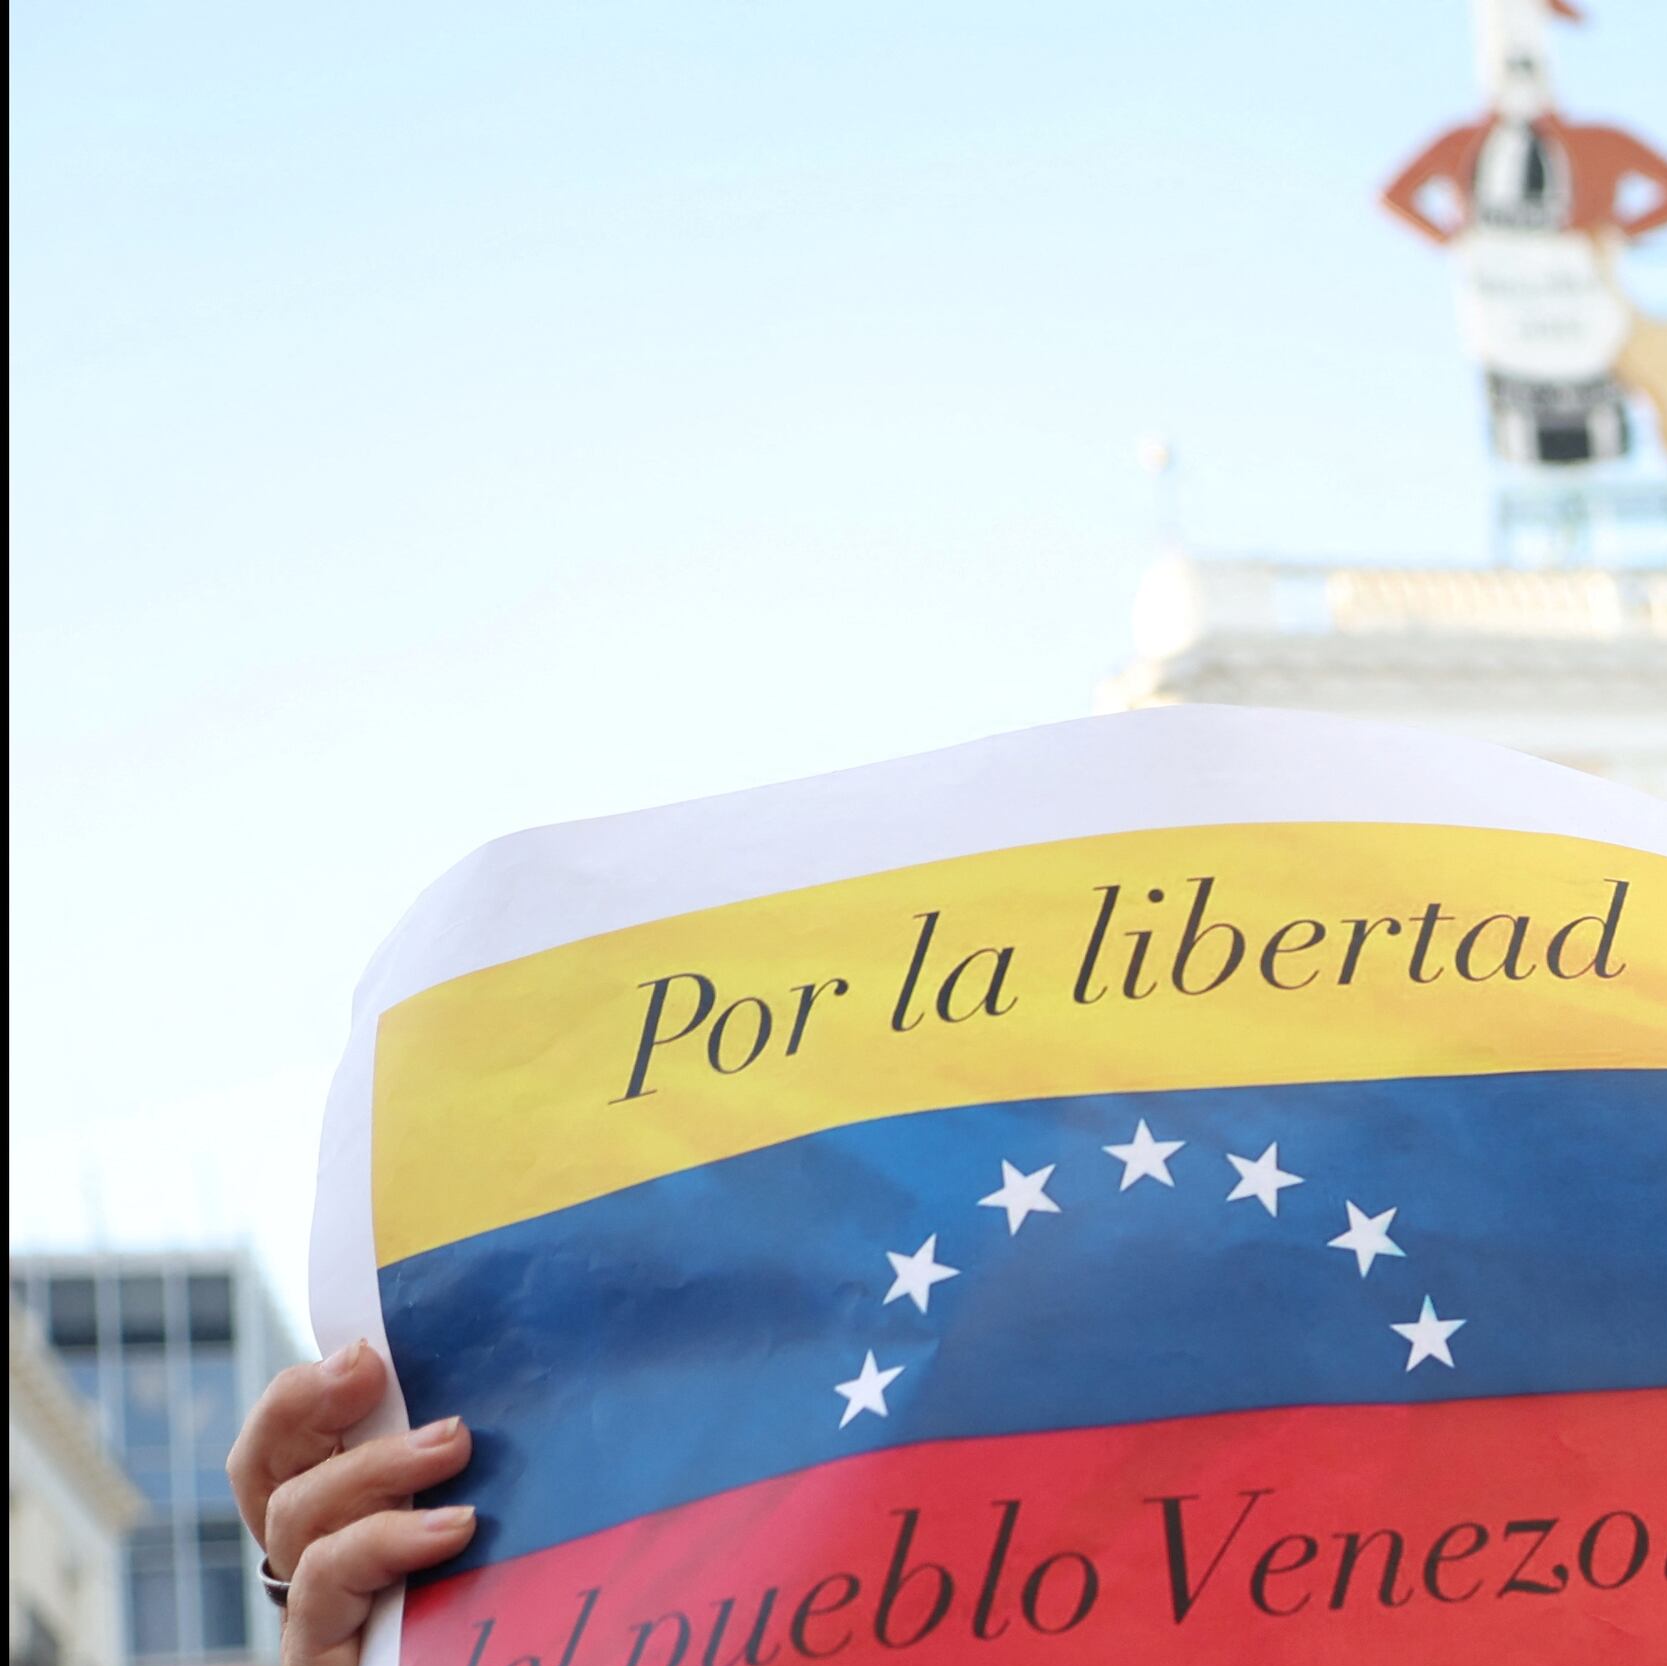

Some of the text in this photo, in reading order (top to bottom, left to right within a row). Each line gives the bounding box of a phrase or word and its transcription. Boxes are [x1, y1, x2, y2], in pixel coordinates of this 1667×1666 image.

[608, 876, 1630, 1105] Por la libertad
